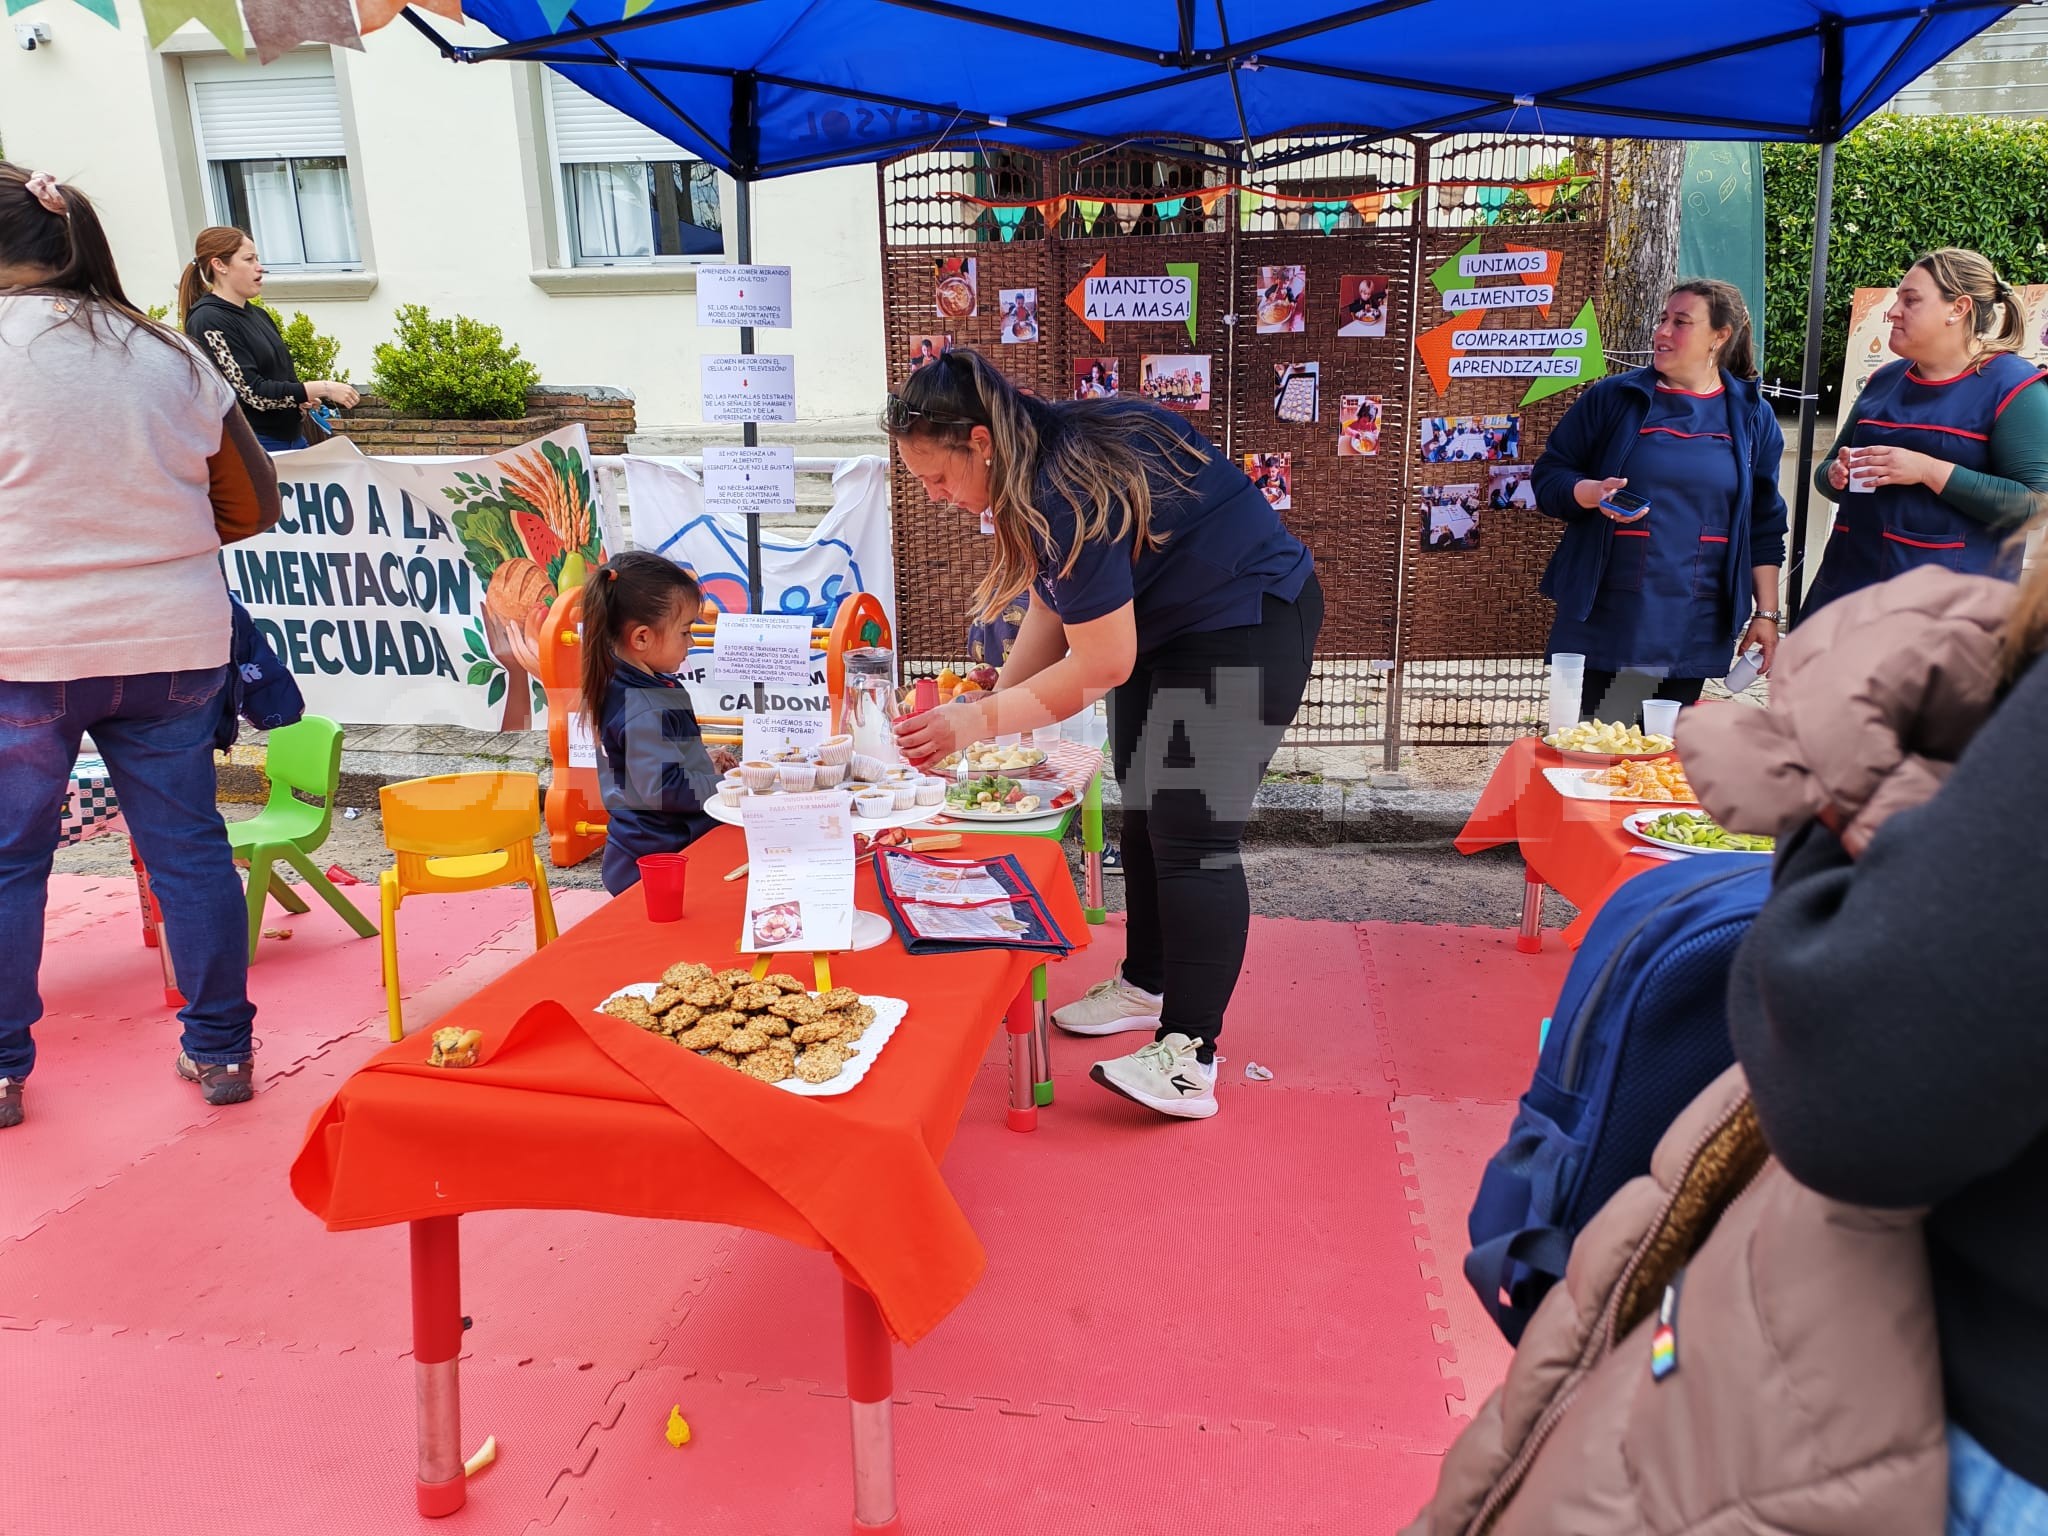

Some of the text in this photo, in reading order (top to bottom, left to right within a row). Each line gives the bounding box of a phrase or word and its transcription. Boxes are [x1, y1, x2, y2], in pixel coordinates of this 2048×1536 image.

[1467, 257, 1540, 274] ¡UNIMOS
[1090, 279, 1186, 295] ¡MANITOS
[1450, 289, 1549, 306] ALIMENTOS
[1086, 301, 1190, 317] A LA MASA!
[1455, 332, 1583, 346] COMPRARTIMOS
[1452, 360, 1577, 373] APRENDIZAJES!
[264, 482, 453, 544] CHO A LA
[753, 716, 770, 725] ¿QUÉ
